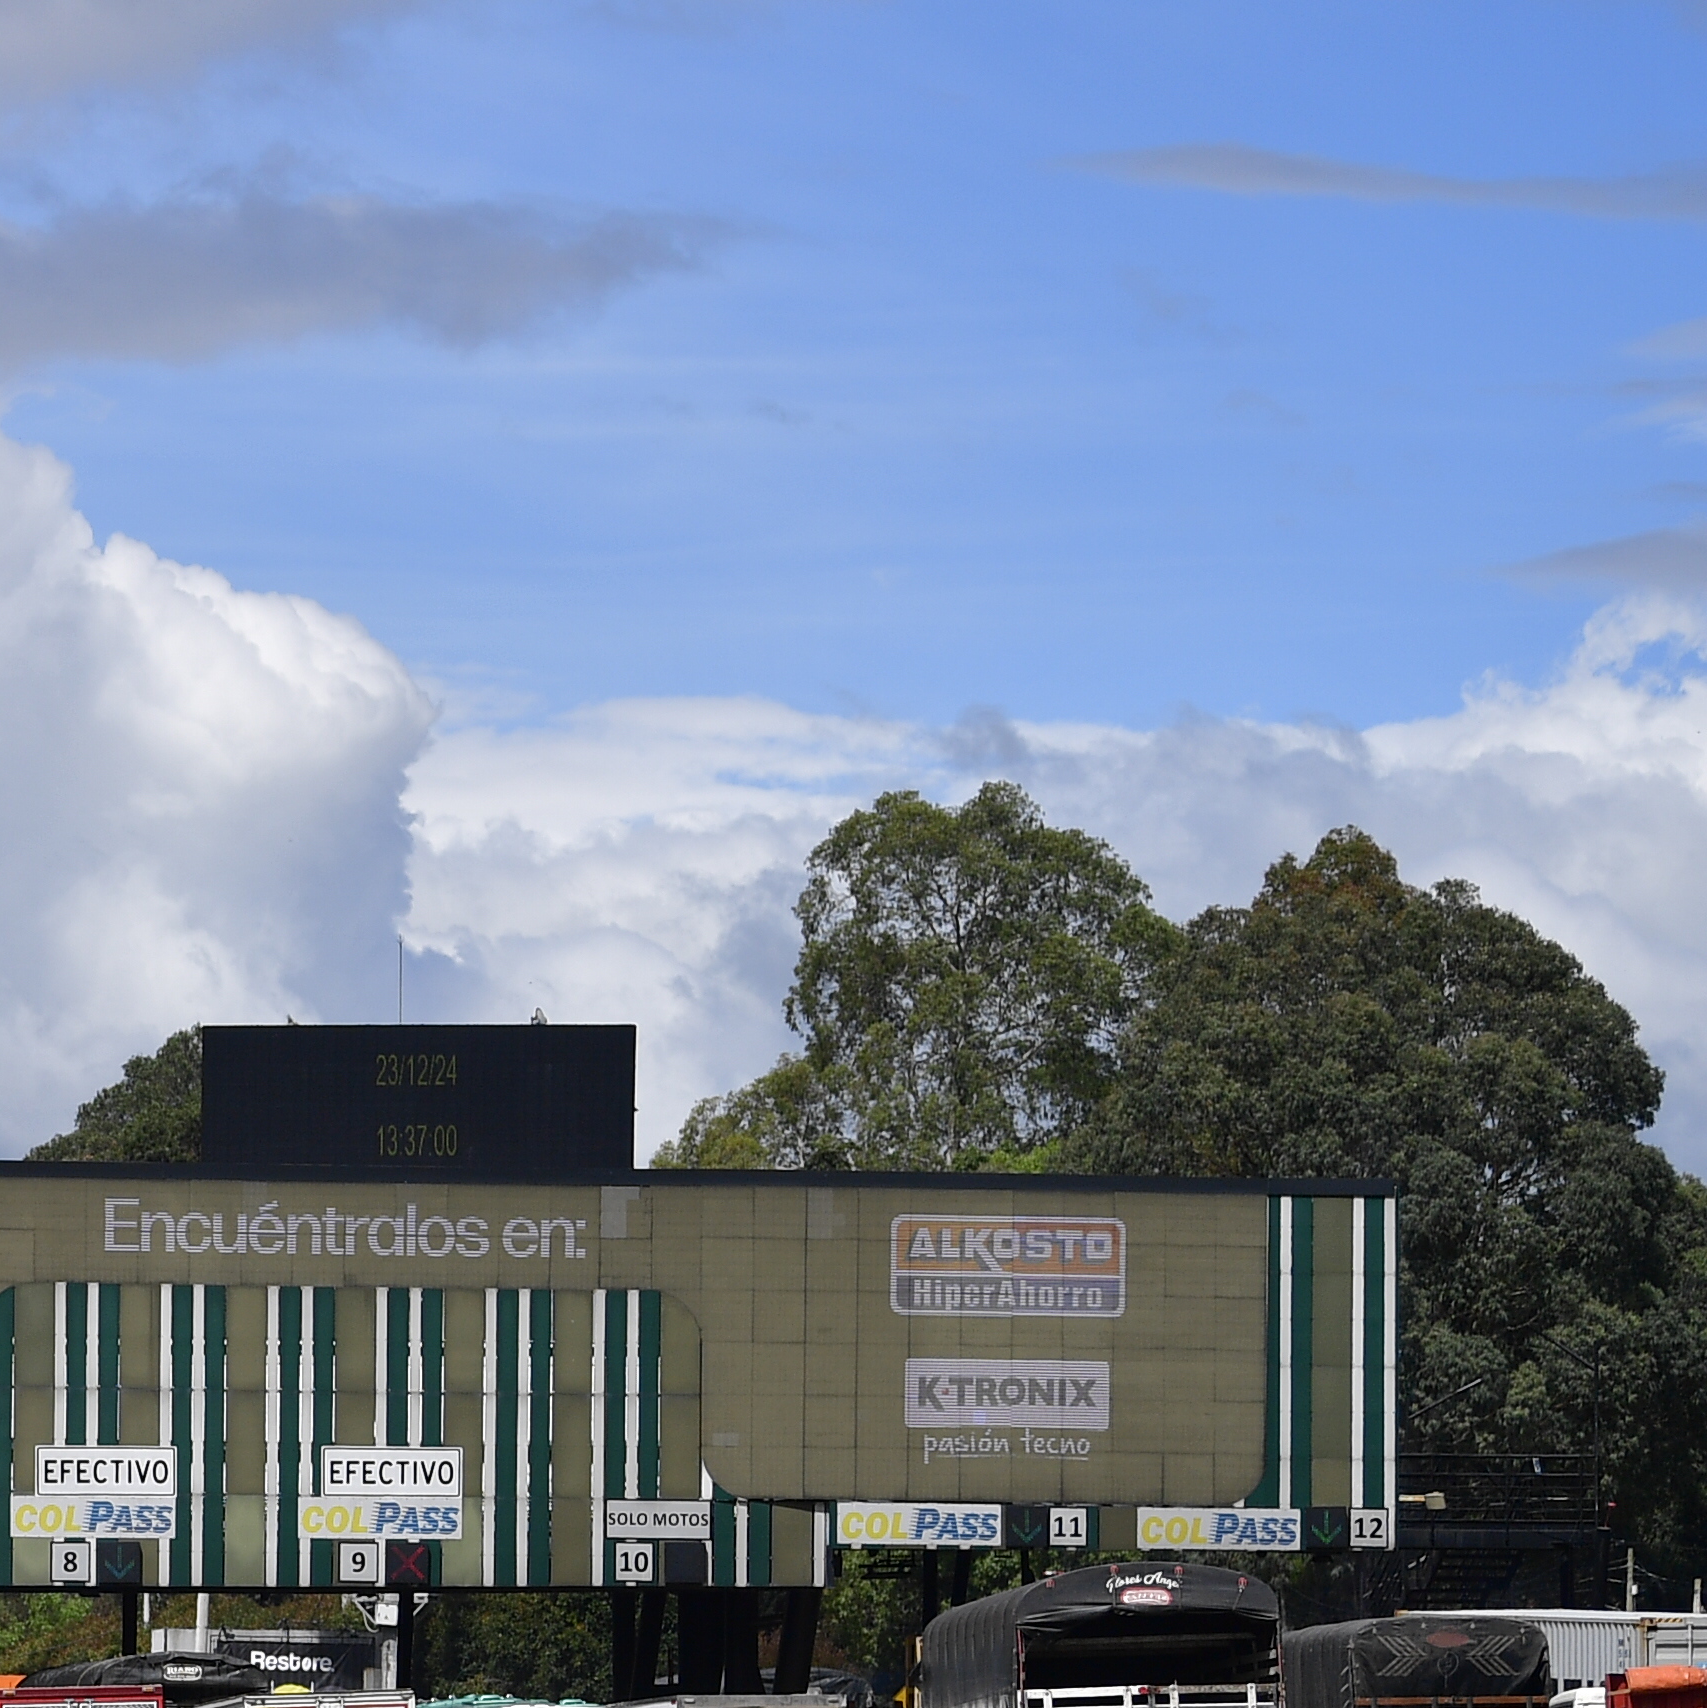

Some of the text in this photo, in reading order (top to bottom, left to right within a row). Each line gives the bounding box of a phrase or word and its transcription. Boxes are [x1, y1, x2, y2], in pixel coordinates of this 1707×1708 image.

[375, 1053, 458, 1089] 23/12/24
[377, 1125, 458, 1158] 13:37:00
[103, 1198, 587, 1260] Encuéntralos en:
[907, 1226, 1113, 1273] ALKOSTO
[913, 1277, 1104, 1311] HiperAhorro
[923, 1430, 1091, 1466] pasión tecno
[42, 1458, 170, 1487] EFECTIVO
[328, 1458, 455, 1487] EFECTIVO
[608, 1512, 709, 1527] SOLO MOTOS
[1052, 1515, 1083, 1541] 11
[1352, 1515, 1384, 1541] 12
[62, 1551, 78, 1573] 8
[350, 1551, 366, 1573] 9
[618, 1550, 649, 1575] 10
[1144, 1571, 1183, 1590] Ange
